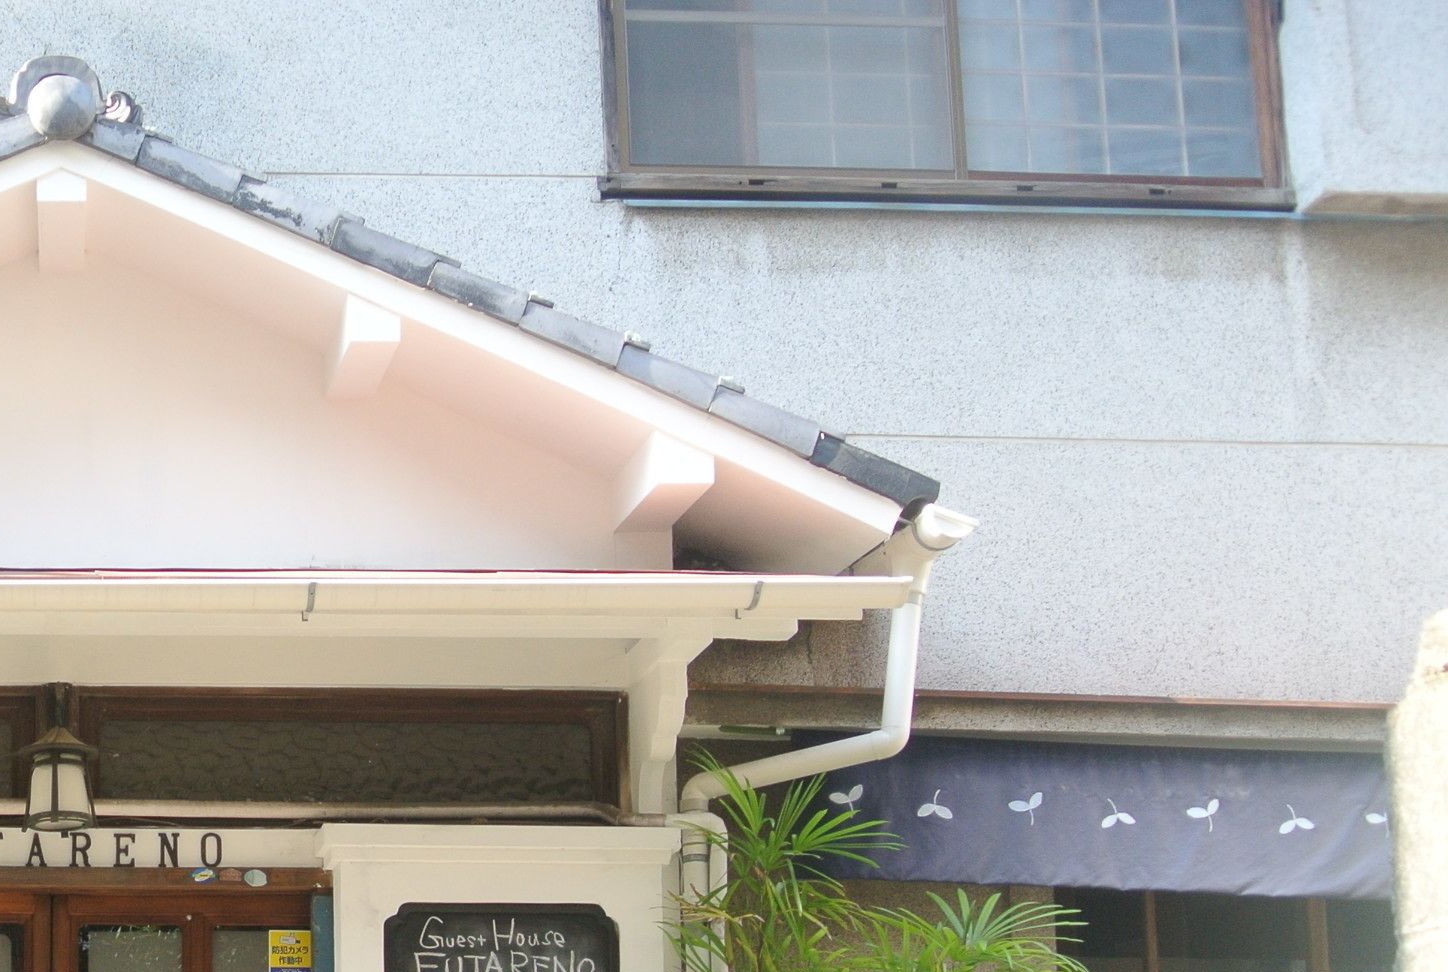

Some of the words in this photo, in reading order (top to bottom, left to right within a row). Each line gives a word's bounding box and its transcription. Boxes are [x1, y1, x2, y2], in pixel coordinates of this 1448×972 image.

[419, 916, 487, 949] Guest
[492, 918, 566, 950] House
[271, 945, 309, 955] 防犯カメラ
